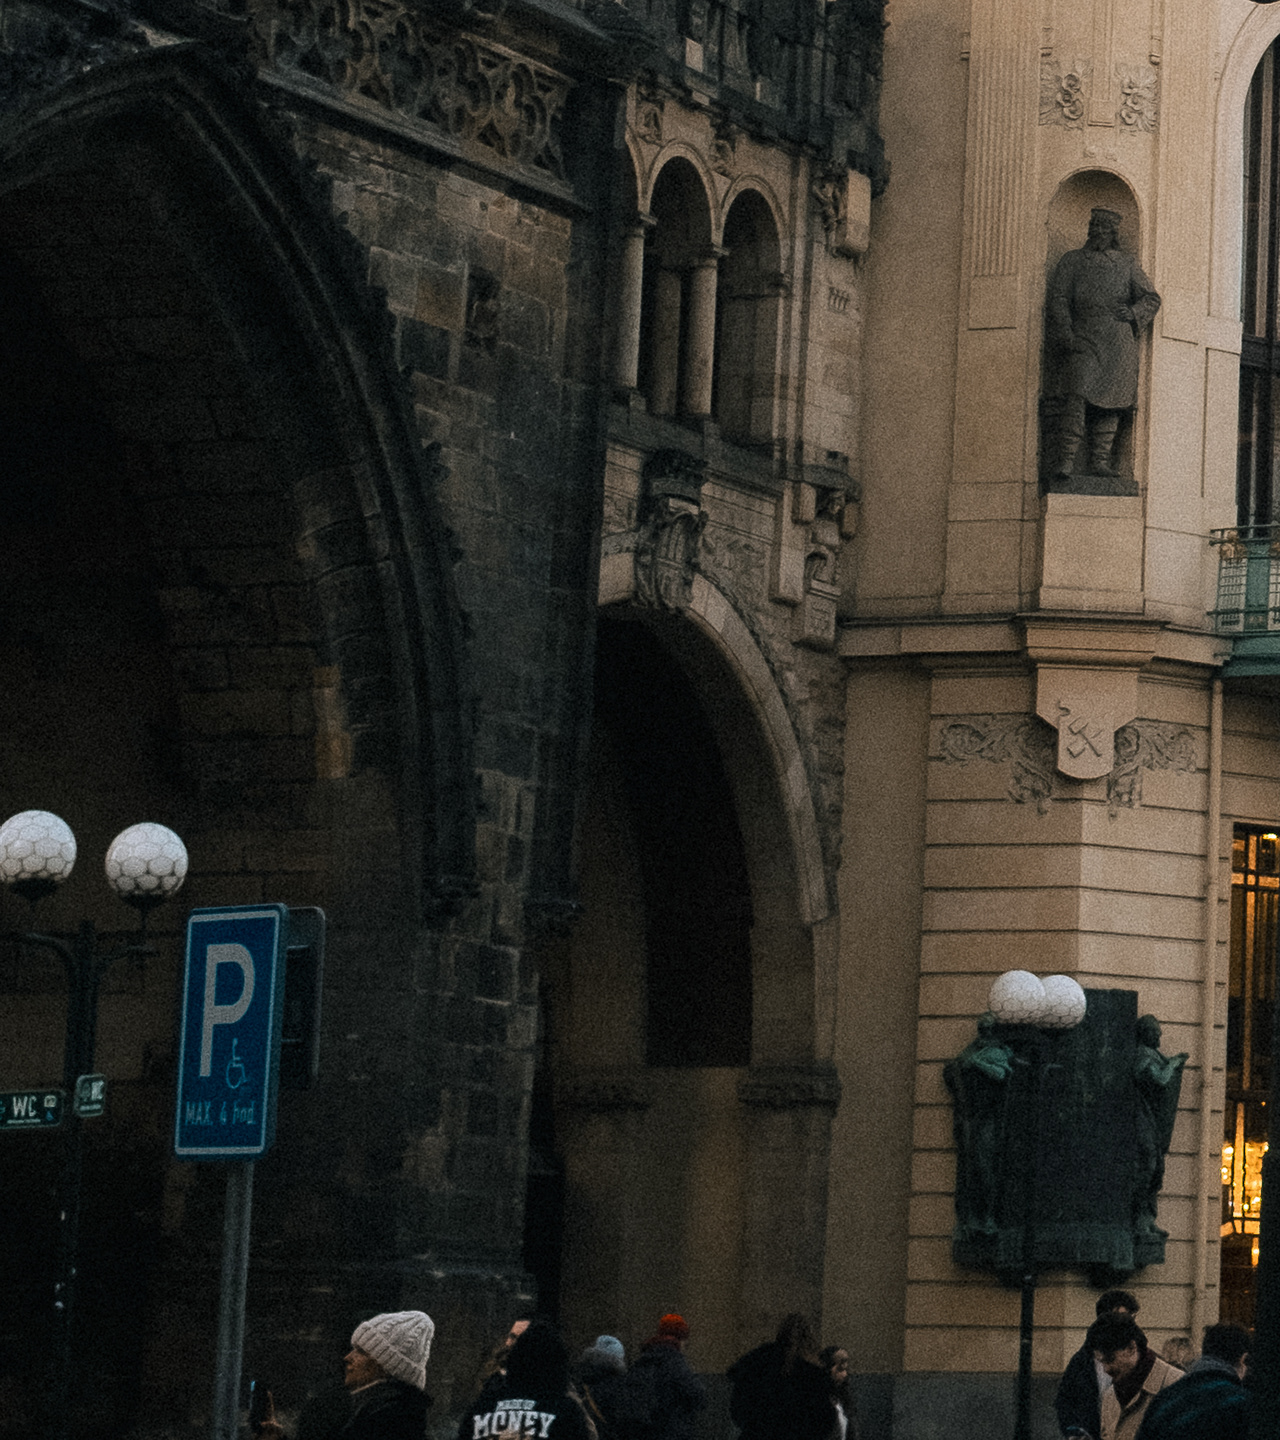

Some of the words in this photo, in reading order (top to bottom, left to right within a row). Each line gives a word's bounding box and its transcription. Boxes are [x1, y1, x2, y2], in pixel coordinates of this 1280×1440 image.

[200, 943, 256, 1077] P
[13, 1095, 37, 1117] WC
[472, 1411, 556, 1440] MONEY
